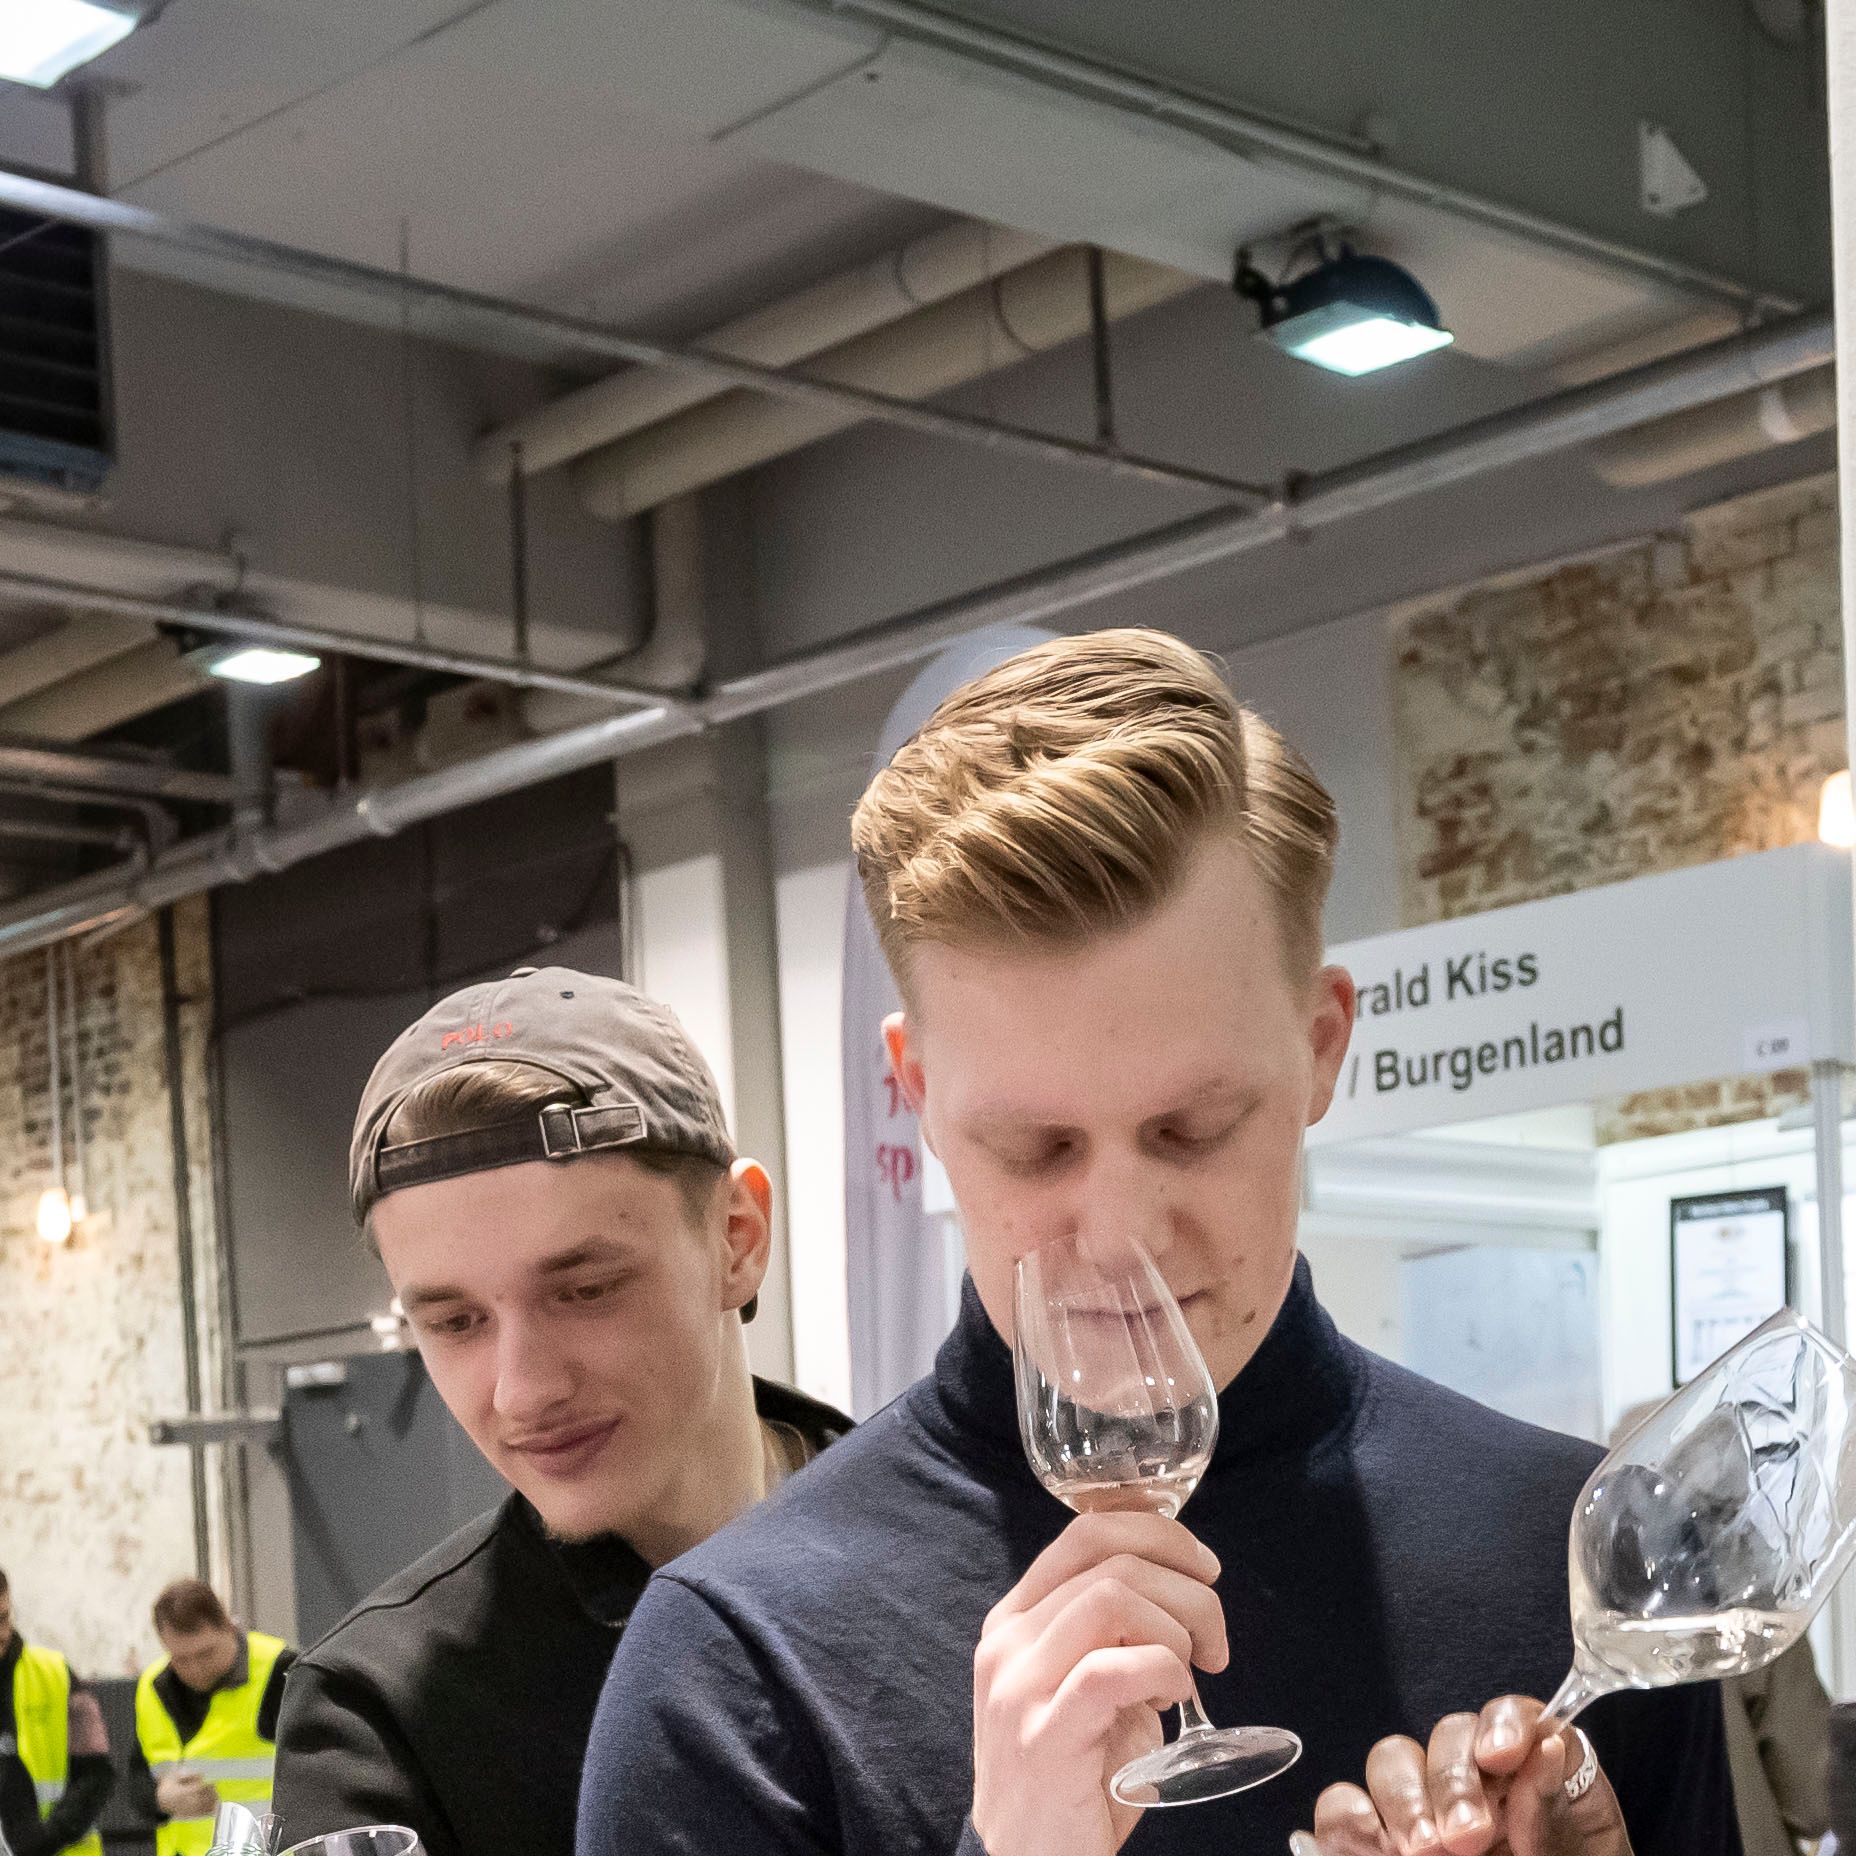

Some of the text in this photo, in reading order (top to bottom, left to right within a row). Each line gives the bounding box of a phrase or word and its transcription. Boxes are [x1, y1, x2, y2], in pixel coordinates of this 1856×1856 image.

[1446, 951, 1539, 1001] Kiss
[441, 1021, 513, 1052] POLO
[1374, 1005, 1625, 1092] Burgenland
